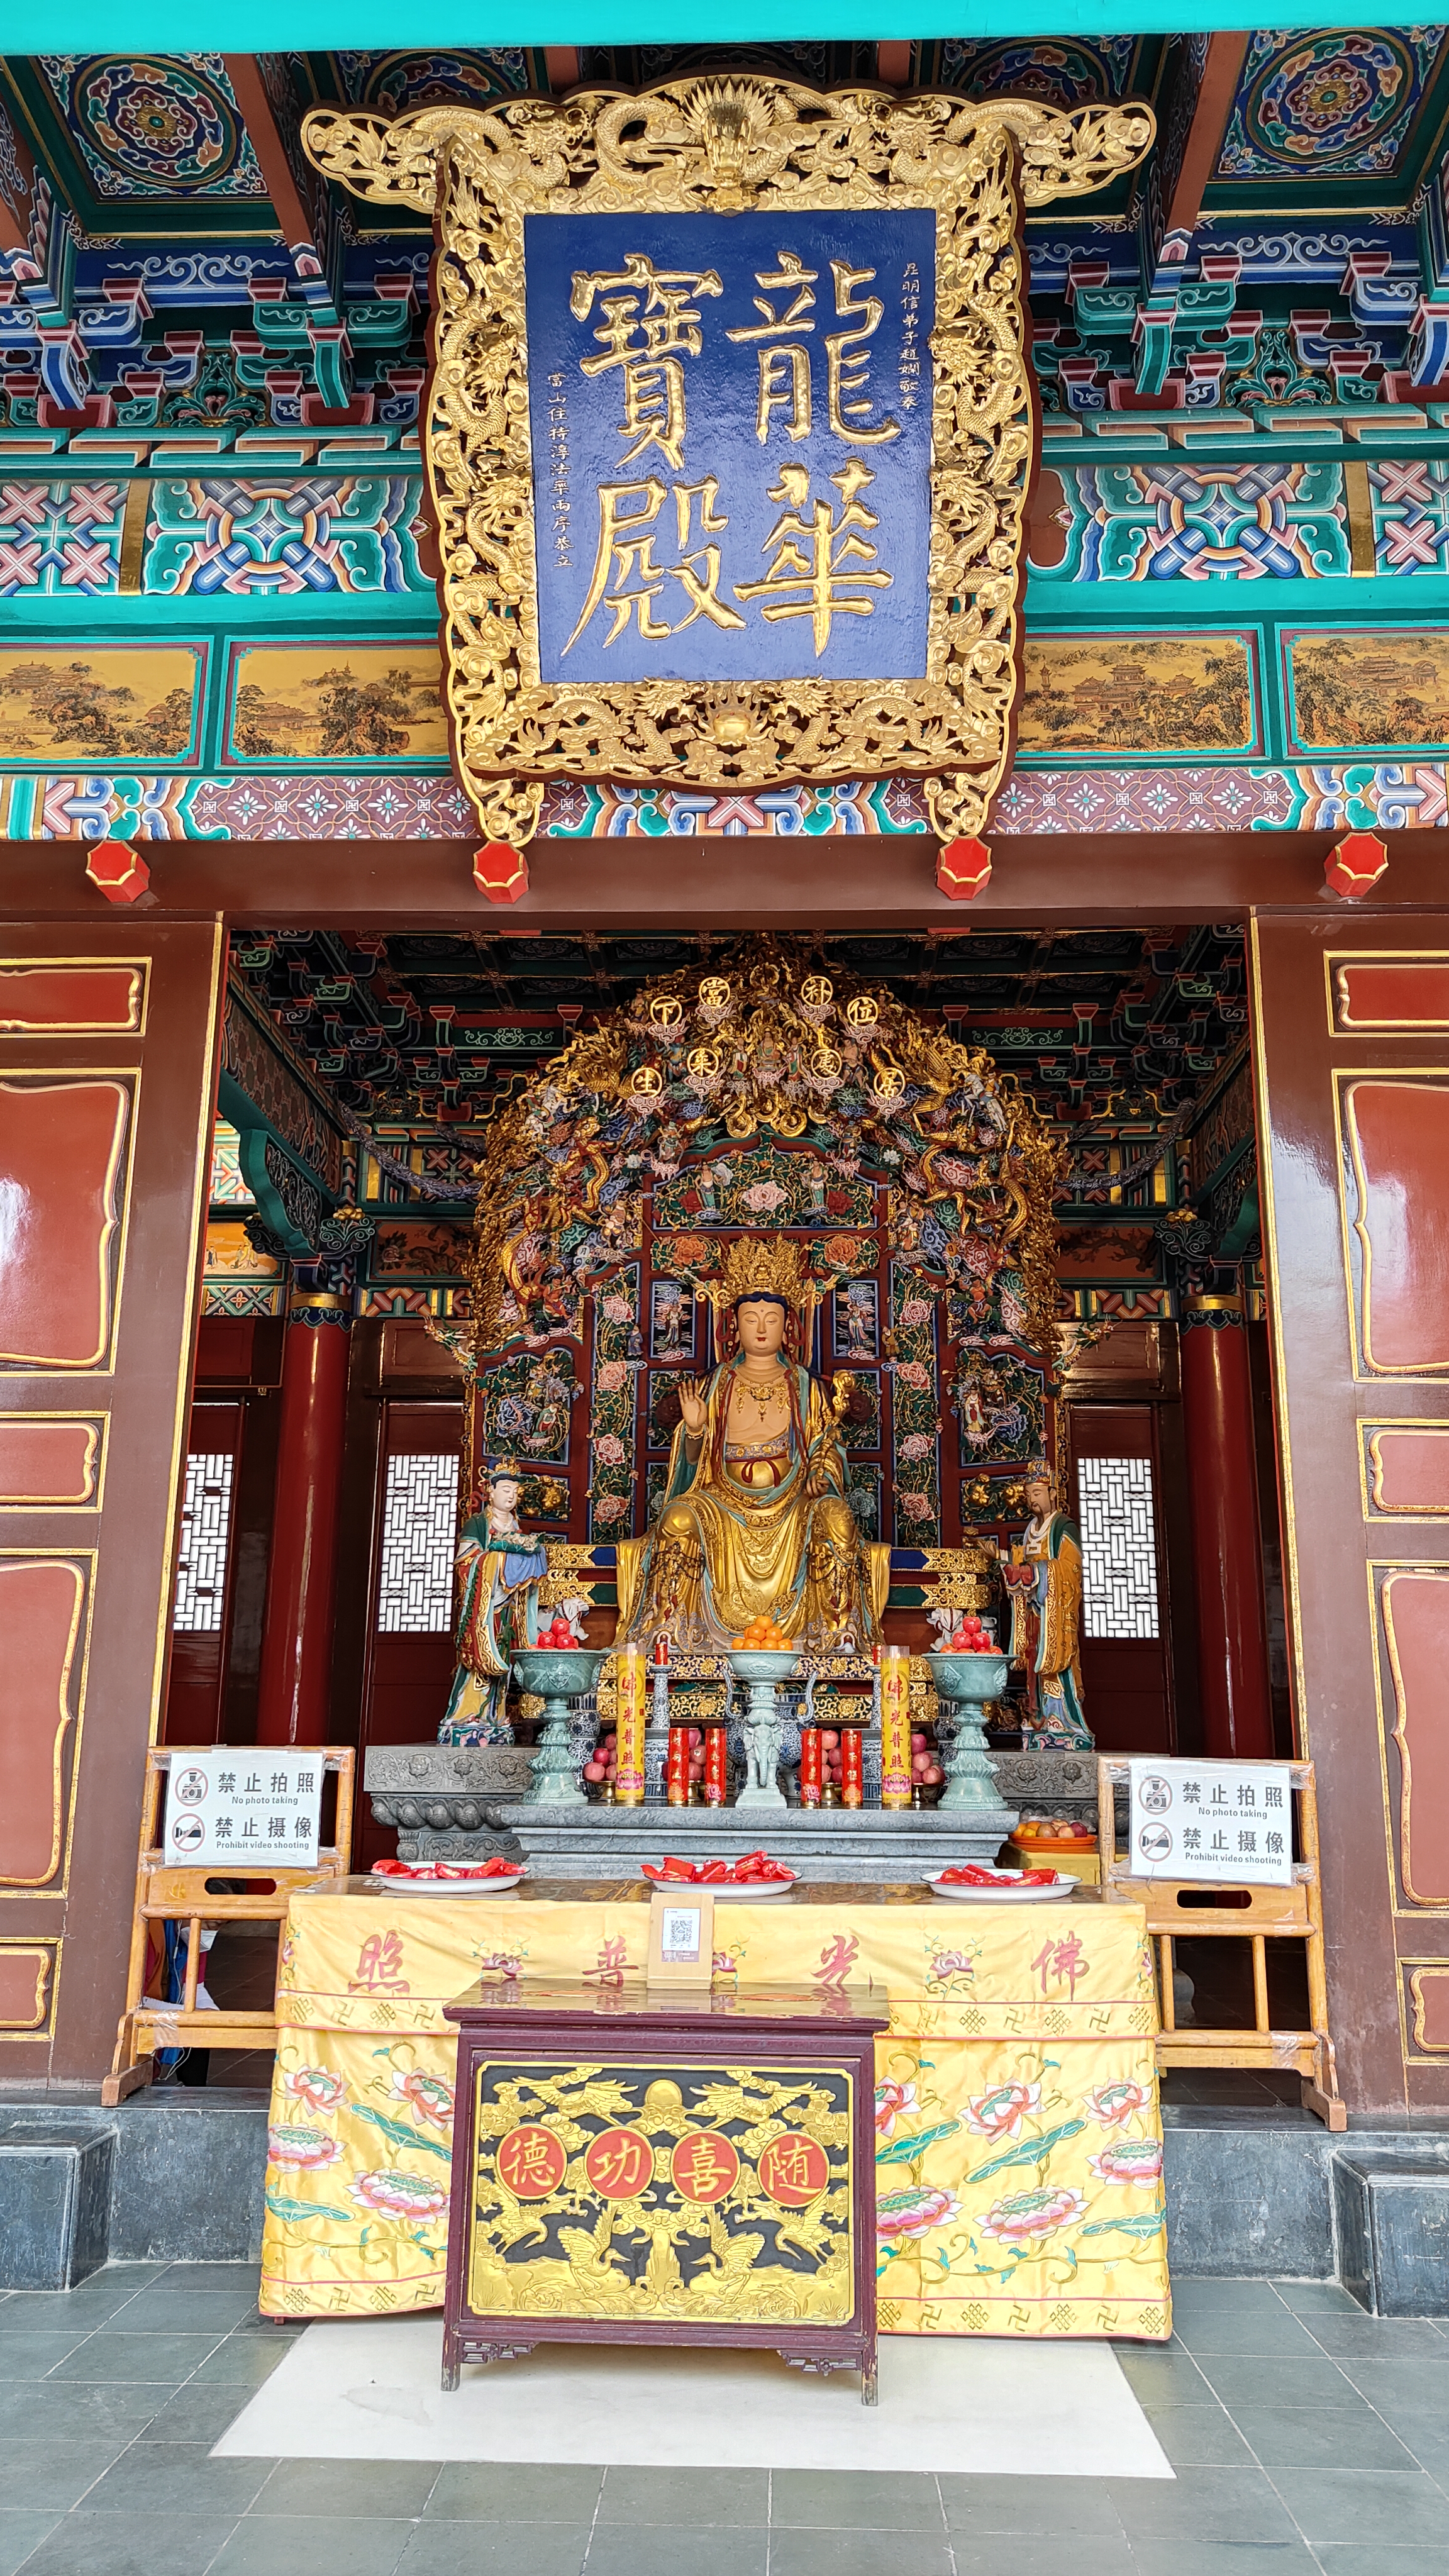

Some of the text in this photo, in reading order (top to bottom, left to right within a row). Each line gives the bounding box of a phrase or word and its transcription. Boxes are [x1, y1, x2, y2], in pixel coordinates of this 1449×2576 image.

[561, 252, 747, 658] 寶殿
[724, 250, 902, 658] 龍華
[218, 1772, 314, 1793] 禁止拍照
[231, 1796, 299, 1806] No photo taking
[1182, 1782, 1283, 1807] 禁止拍照
[1198, 1807, 1268, 1819] No photo taking
[215, 1817, 312, 1838] 禁止摄像
[216, 1841, 309, 1850] Prohibit video shooting
[1182, 1828, 1284, 1853] 禁止摄像
[1185, 1852, 1282, 1867] Prohibit video shooting
